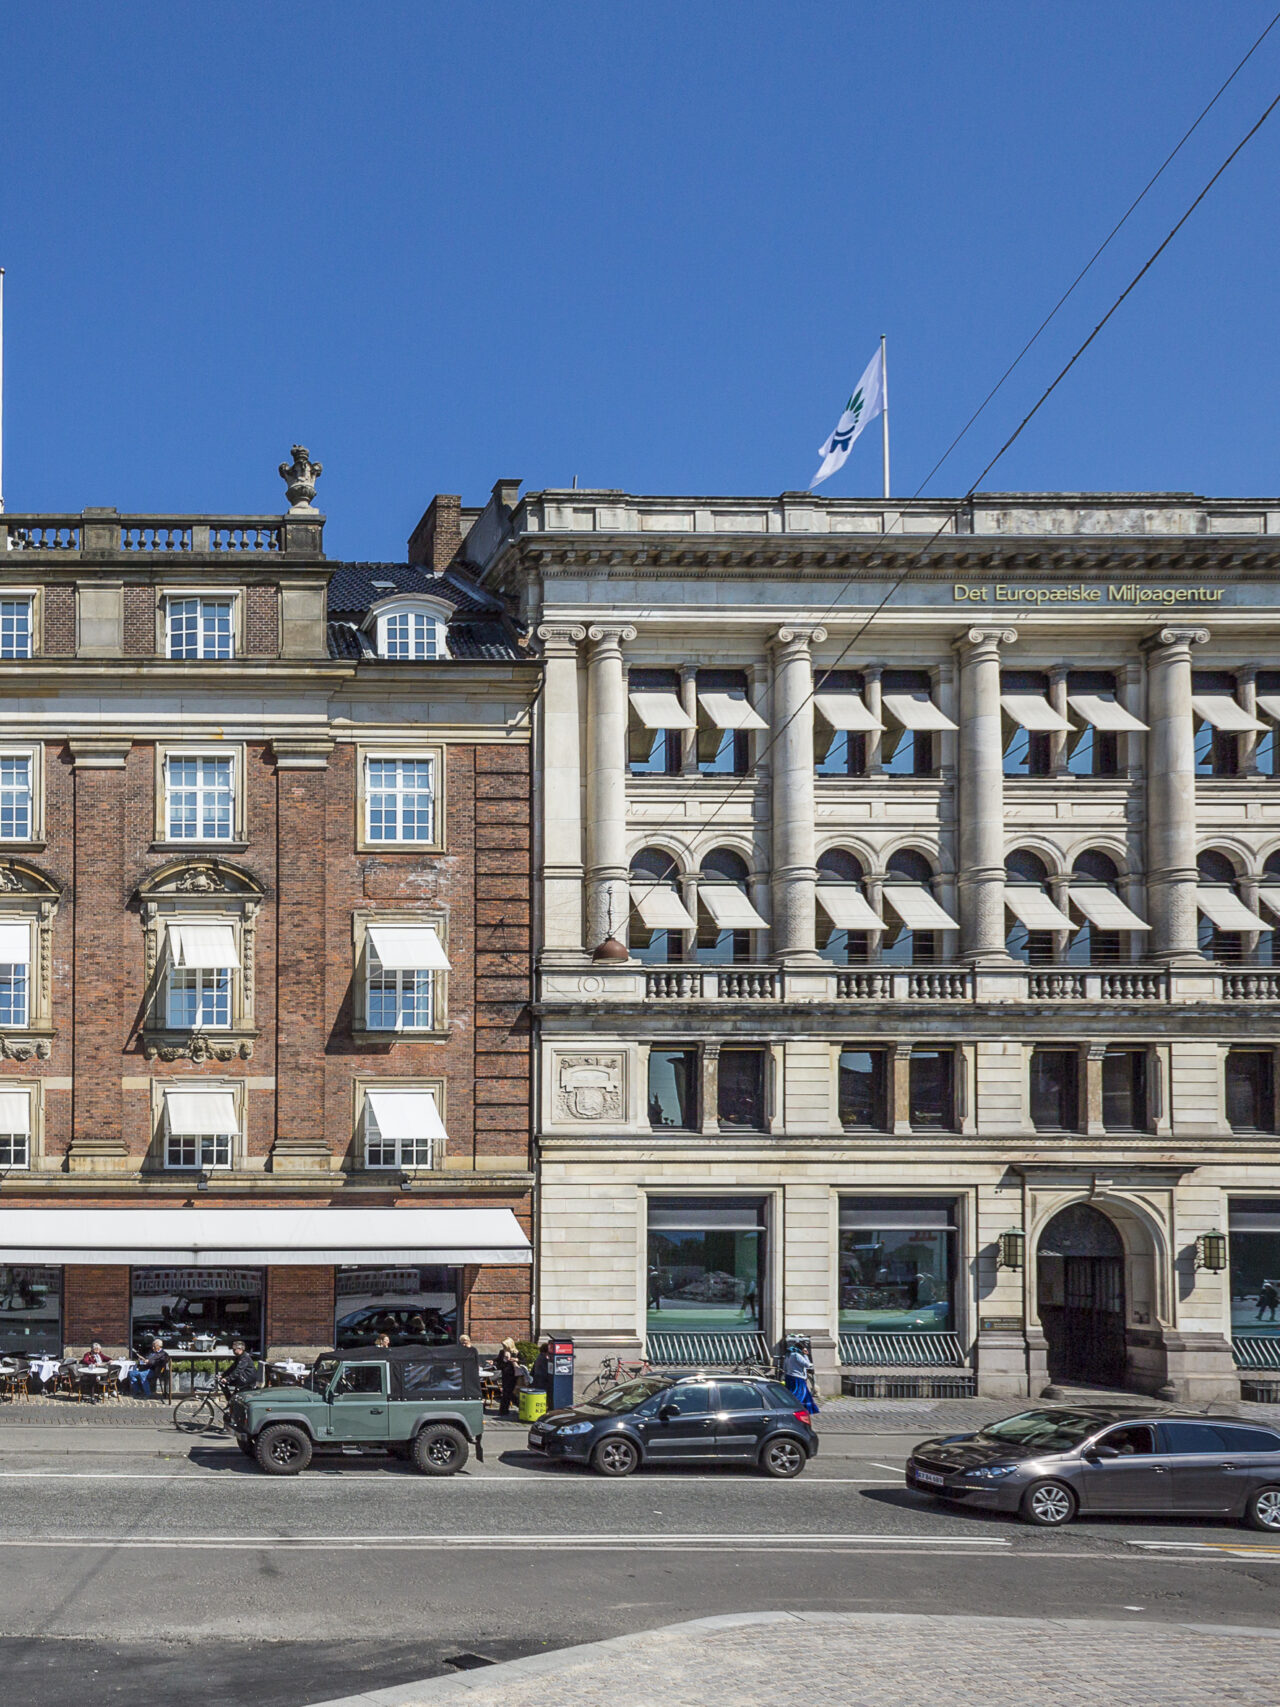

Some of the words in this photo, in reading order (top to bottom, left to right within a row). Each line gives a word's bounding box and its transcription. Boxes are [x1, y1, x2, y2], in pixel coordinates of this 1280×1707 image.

[953, 584, 988, 601] Det
[995, 584, 1101, 605] Europæiske
[1108, 584, 1225, 605] Miljøagentur
